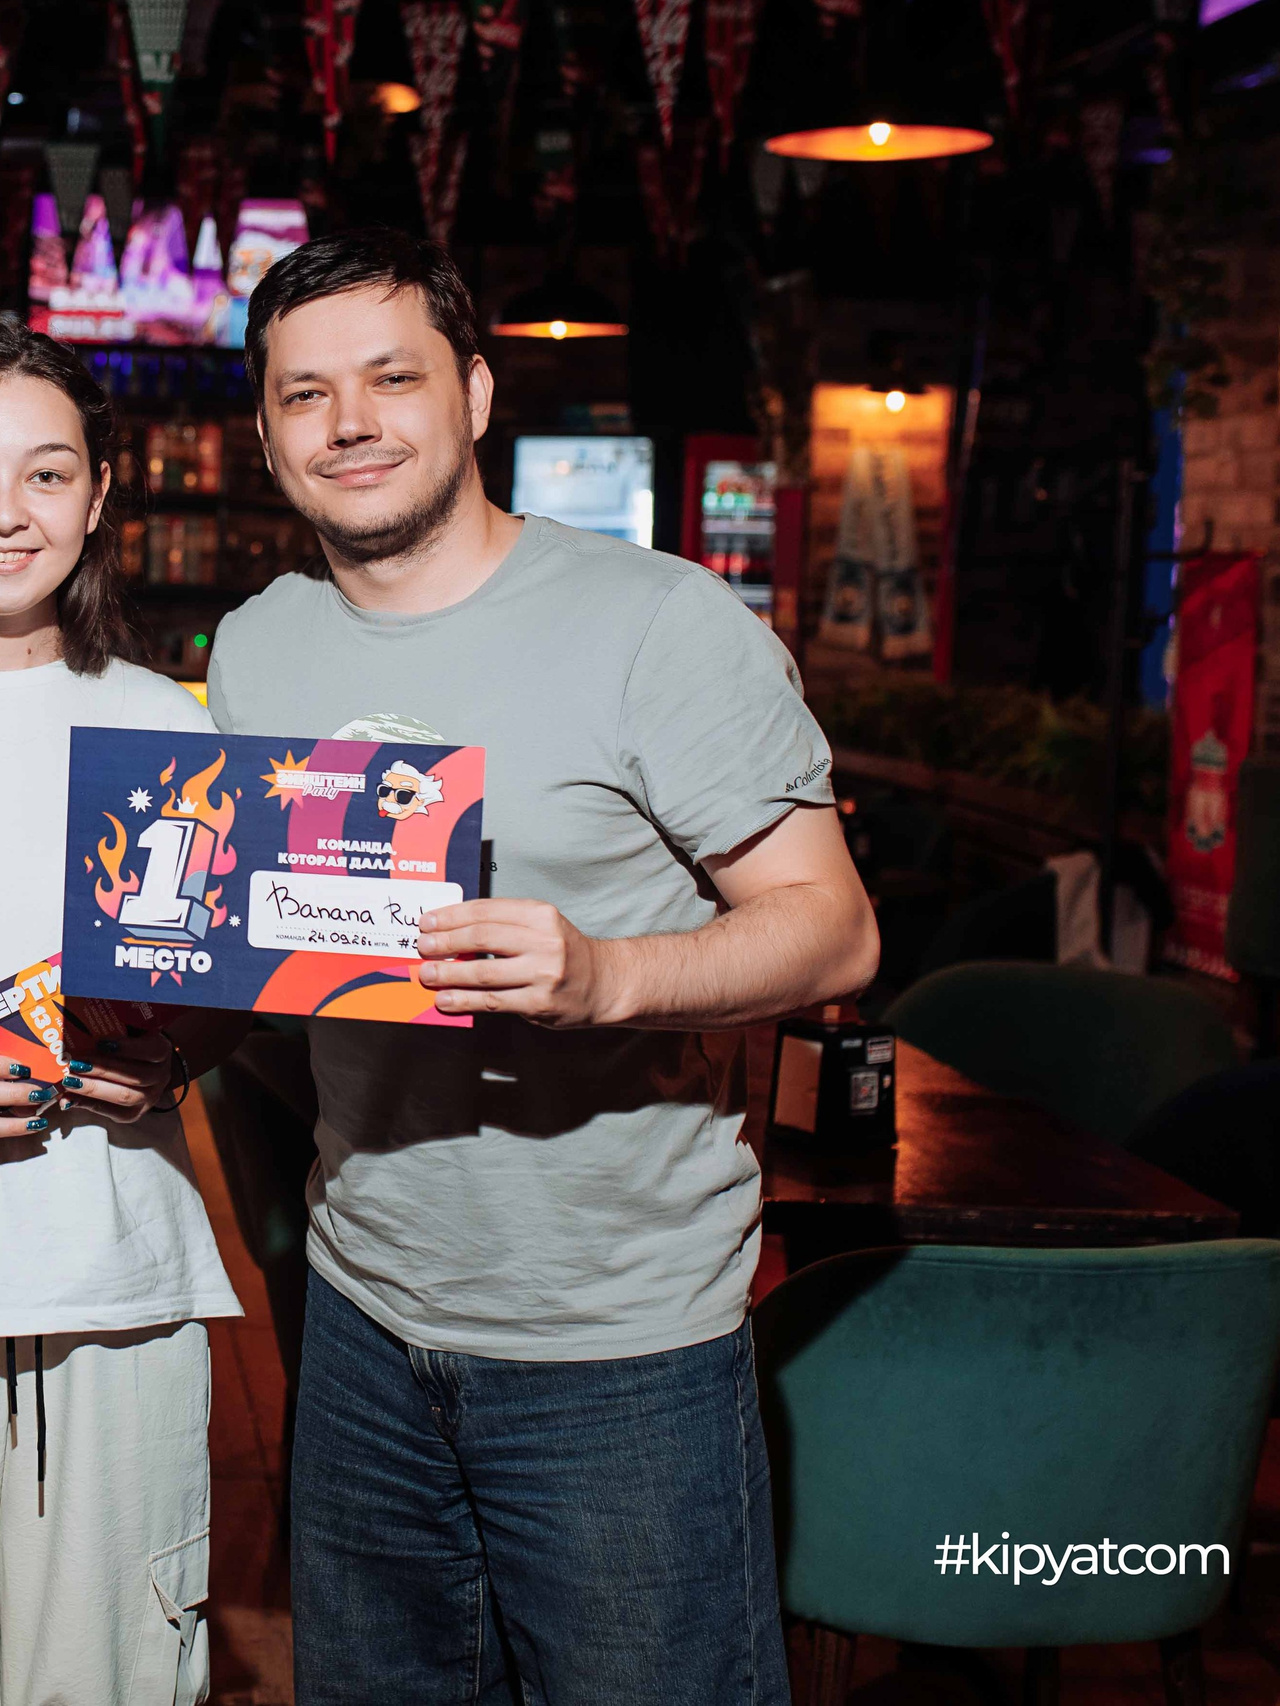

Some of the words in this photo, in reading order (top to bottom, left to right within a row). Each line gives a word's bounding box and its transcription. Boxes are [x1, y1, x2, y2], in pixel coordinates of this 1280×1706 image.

[793, 757, 832, 789] Columbia
[302, 783, 340, 800] Party
[317, 838, 397, 855] КОМАНДА,
[118, 818, 206, 934] 1
[277, 852, 348, 868] КОТОРАЯ
[349, 856, 395, 871] ДАЛА
[398, 860, 437, 873] ОГНЯ
[266, 880, 375, 925] Banana
[114, 945, 213, 974] МЕСТО
[29, 1005, 52, 1030] 13
[42, 1027, 72, 1066] 000
[55, 1016, 64, 1028] НА
